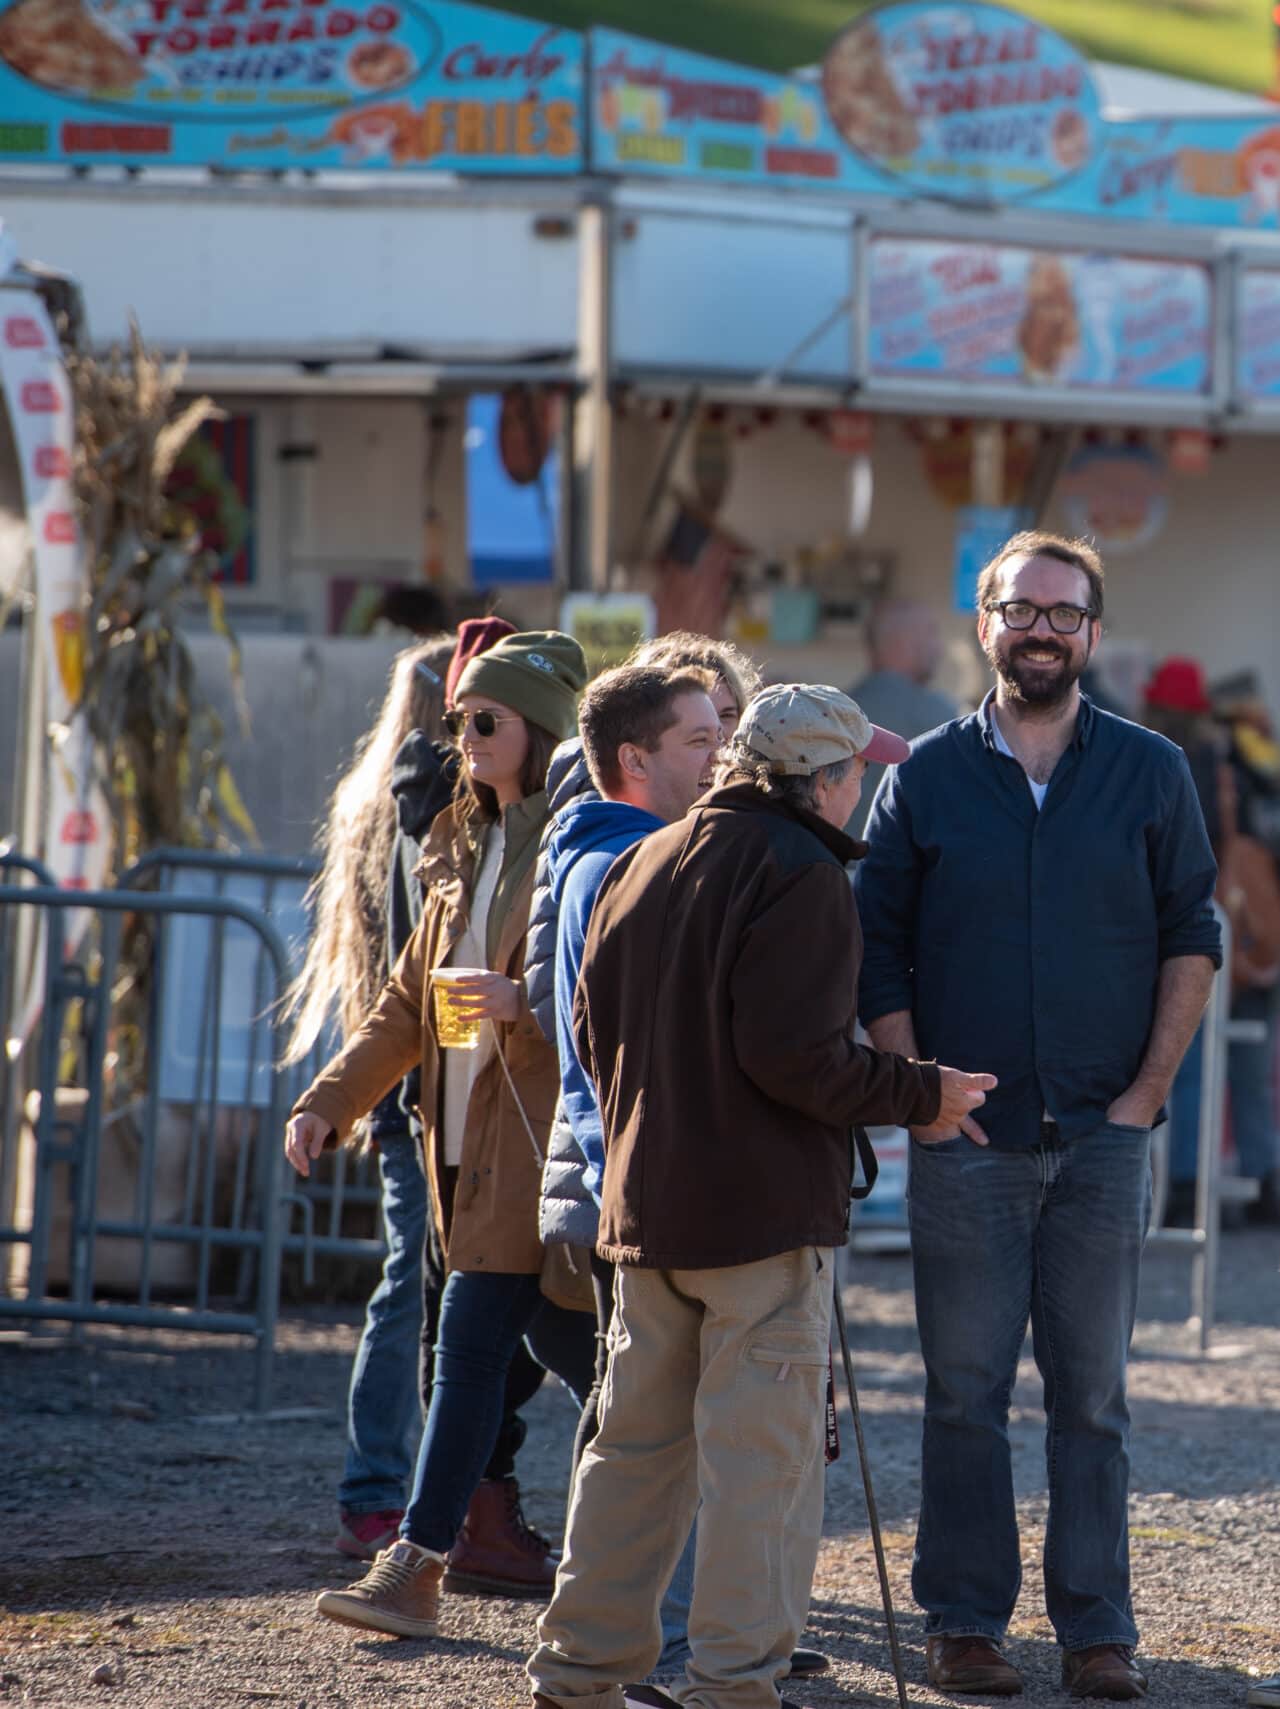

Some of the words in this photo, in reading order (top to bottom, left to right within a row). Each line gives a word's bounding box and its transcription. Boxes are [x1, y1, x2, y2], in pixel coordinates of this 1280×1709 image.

[132, 7, 399, 57] TORNADO
[179, 45, 340, 84] CHIPS
[442, 26, 564, 102] Curly
[423, 98, 579, 157] FRIES
